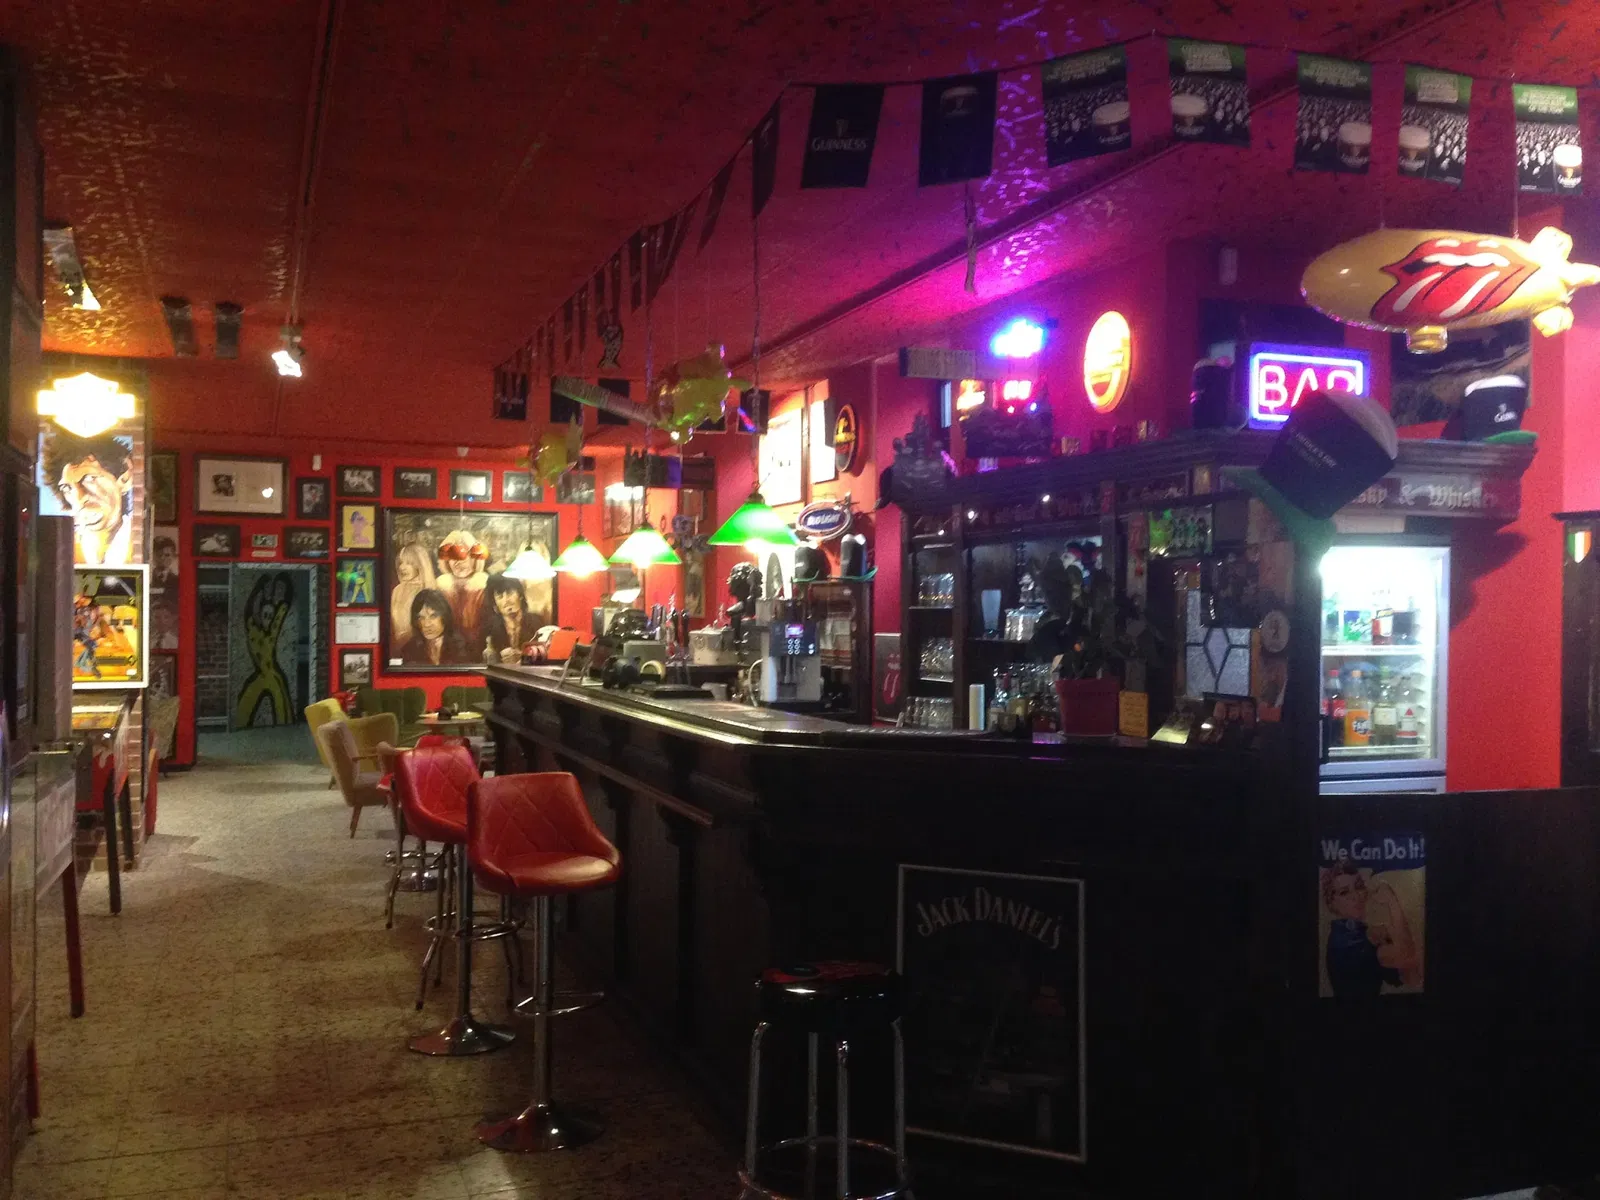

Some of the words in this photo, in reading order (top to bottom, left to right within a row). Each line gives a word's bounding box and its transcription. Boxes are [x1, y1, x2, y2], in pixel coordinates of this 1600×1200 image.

[811, 137, 868, 152] GUINNESS
[1399, 484, 1416, 506] &
[1320, 839, 1348, 861] We
[1351, 839, 1381, 860] Can
[1384, 838, 1407, 860] Do
[1409, 836, 1426, 860] It!
[915, 894, 973, 938] JACK
